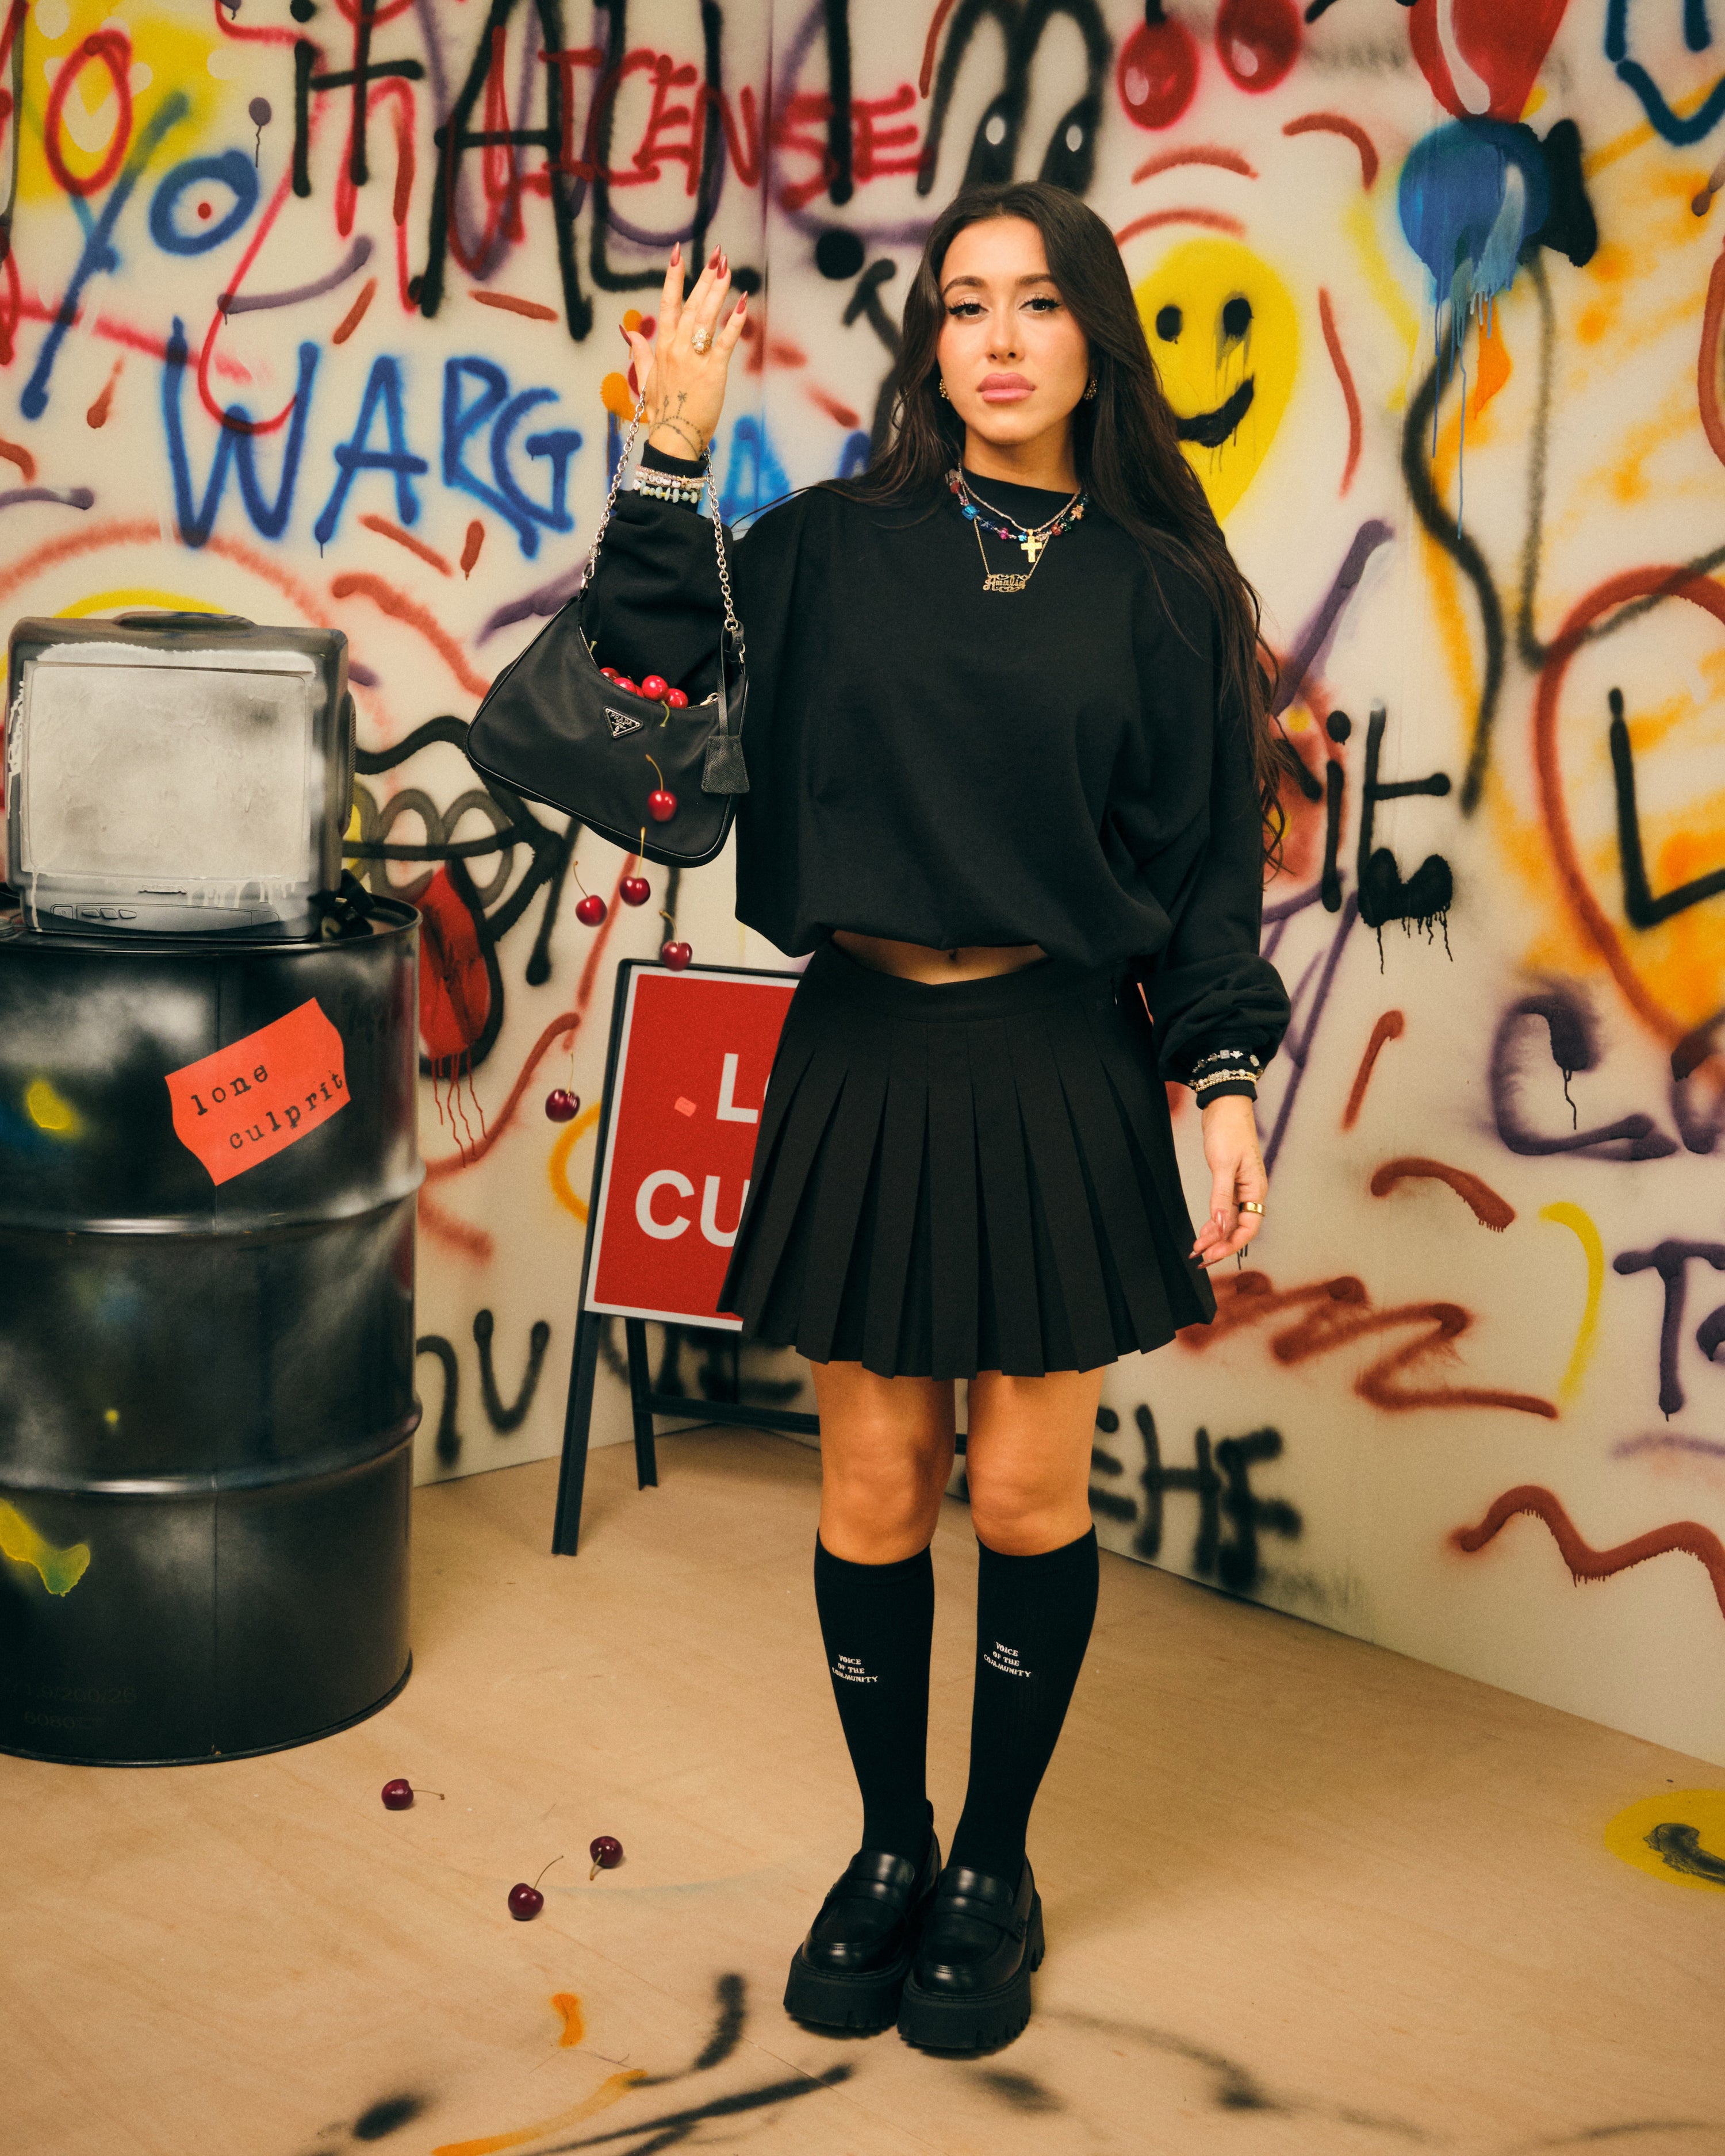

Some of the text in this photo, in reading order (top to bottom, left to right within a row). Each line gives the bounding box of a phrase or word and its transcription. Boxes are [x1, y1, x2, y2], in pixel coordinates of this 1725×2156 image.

[190, 1064, 269, 1117] lone
[716, 1053, 771, 1124] L
[229, 1070, 344, 1149] culprit
[995, 1641, 1019, 1657] VOICE
[838, 1654, 861, 1665] VOICE
[983, 1654, 1032, 1678] COMMUNITY
[992, 1651, 1020, 1667] OF THE
[831, 1667, 878, 1683] COMMUNITY
[837, 1662, 865, 1674] OF THE
